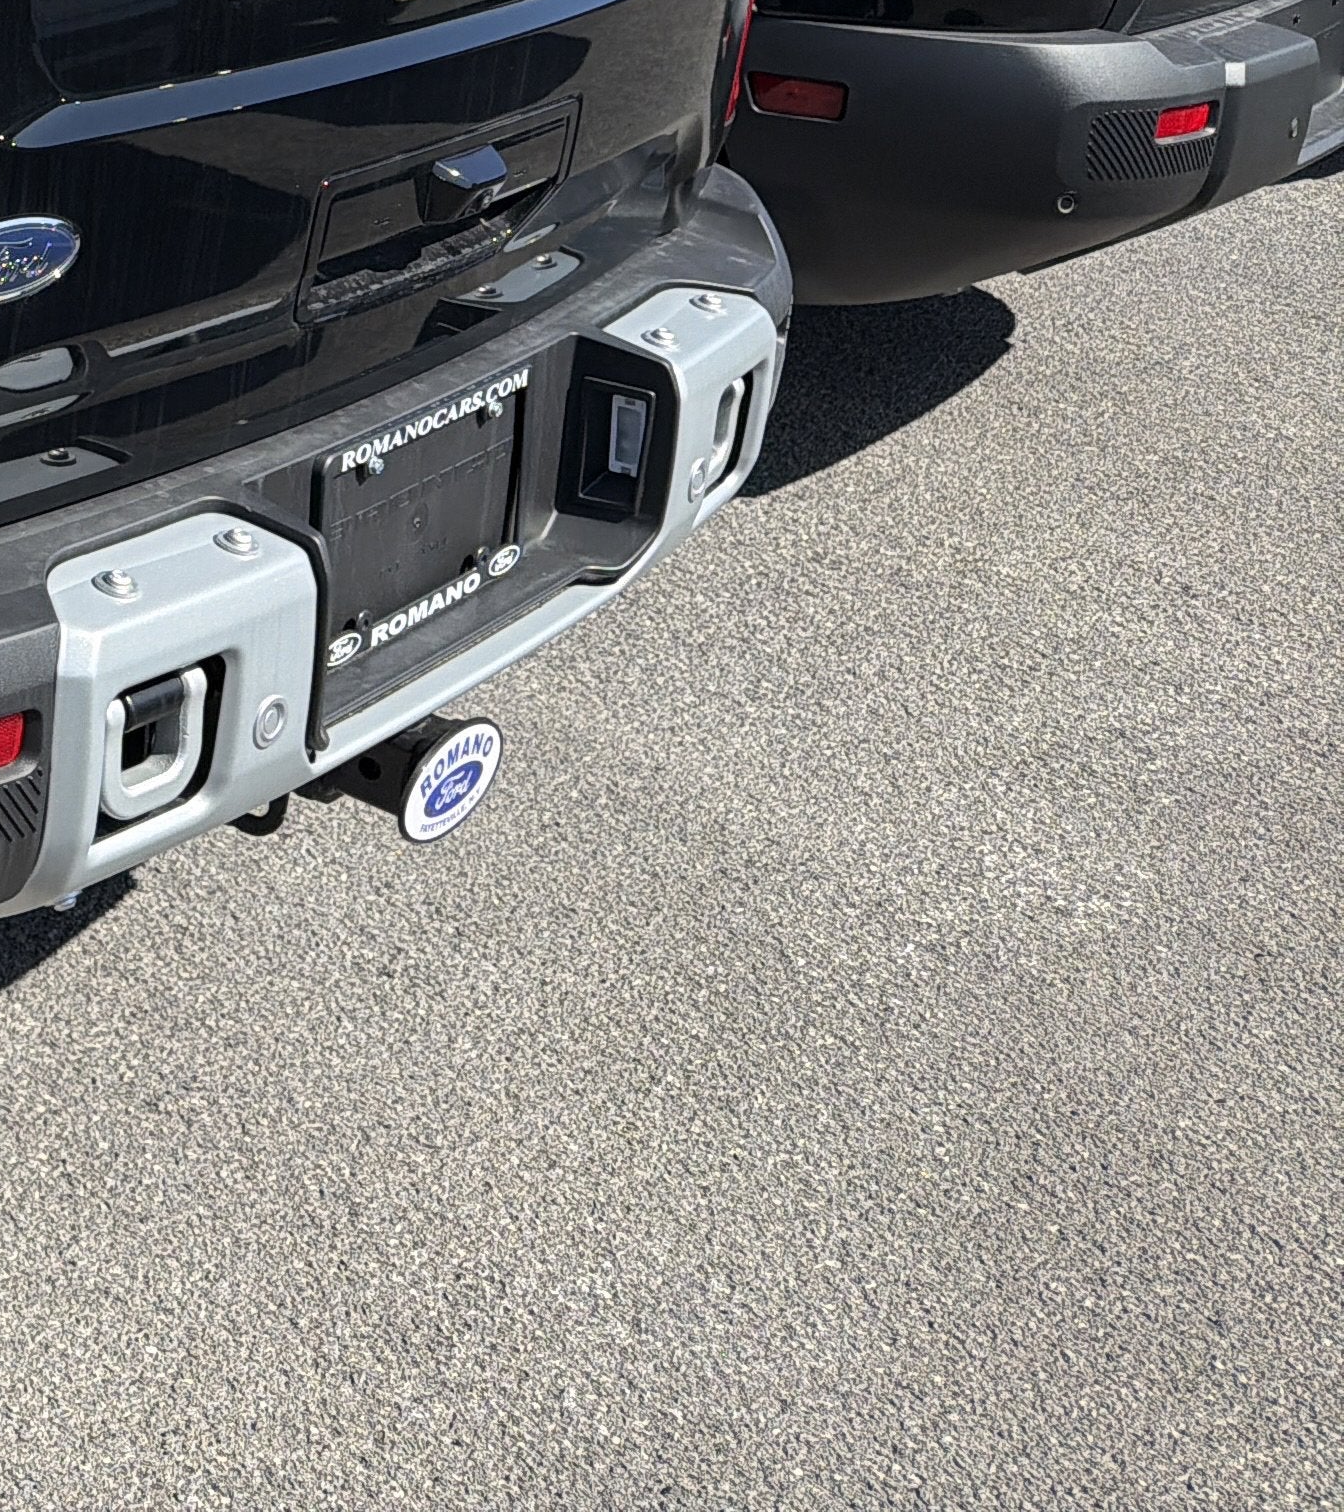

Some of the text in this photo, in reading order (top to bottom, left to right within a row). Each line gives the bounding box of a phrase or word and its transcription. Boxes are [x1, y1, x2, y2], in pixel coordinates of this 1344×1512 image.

[340, 368, 529, 473] ROMANOCARS.COM
[370, 571, 481, 647] ROMANO
[420, 733, 494, 800] ROMANO
[434, 769, 474, 811] Ford
